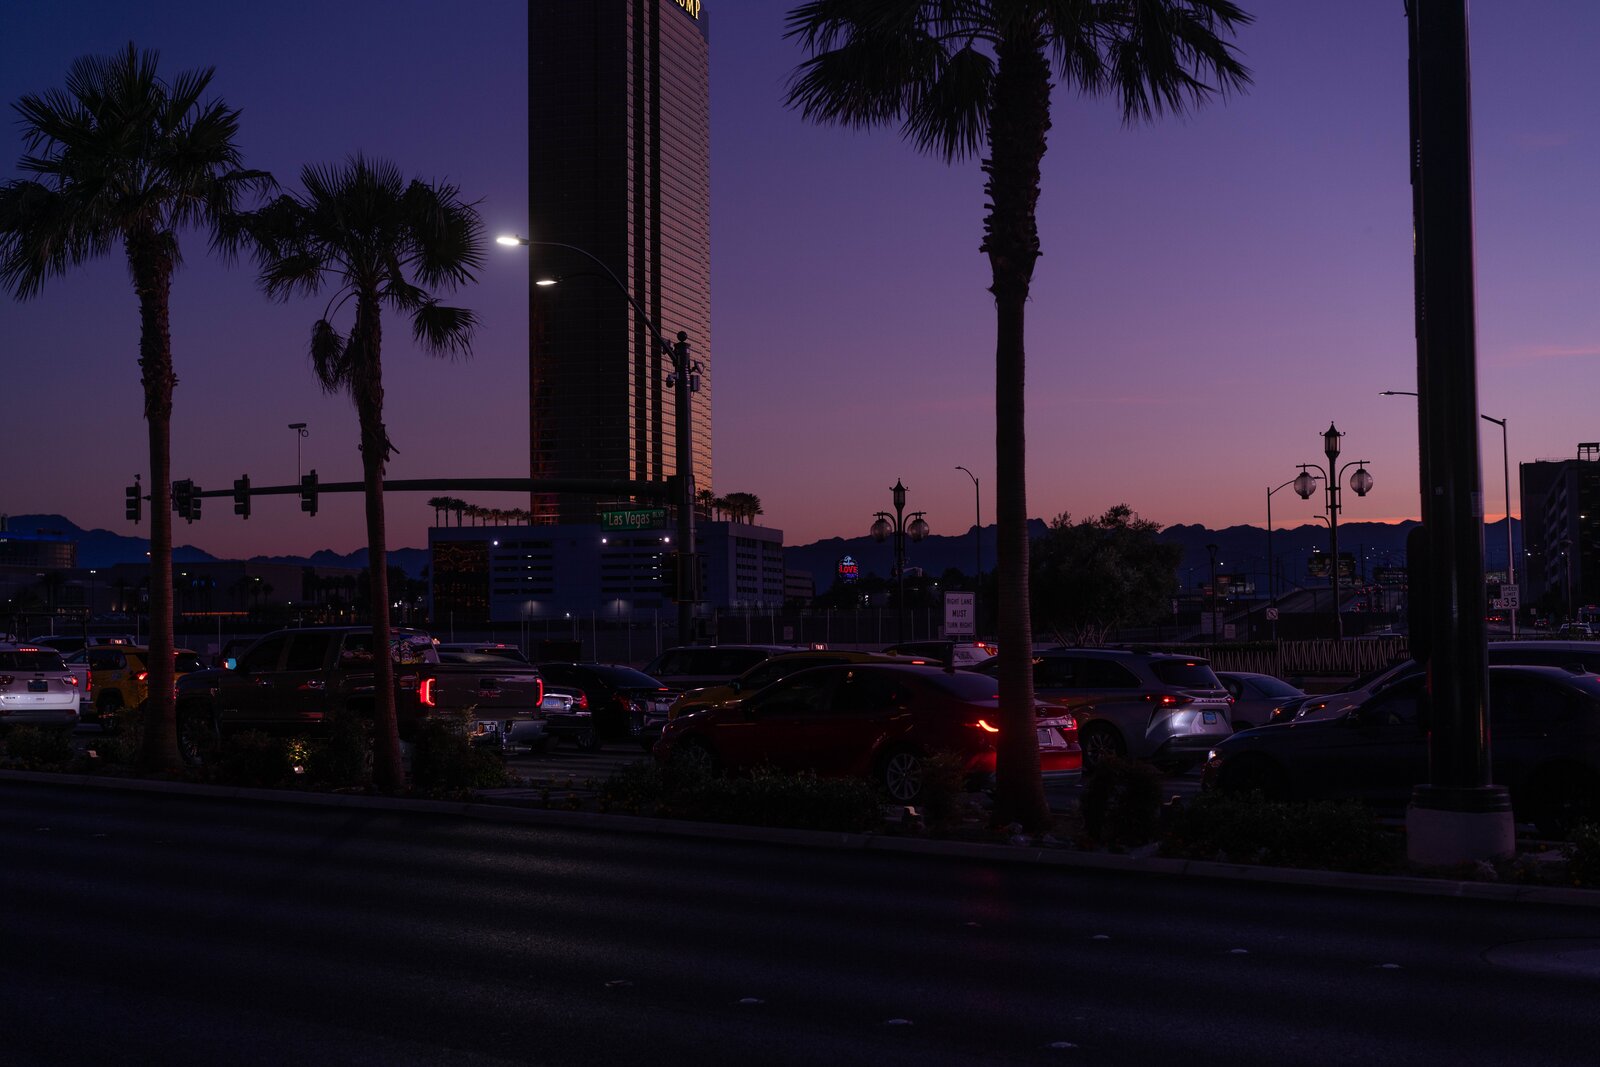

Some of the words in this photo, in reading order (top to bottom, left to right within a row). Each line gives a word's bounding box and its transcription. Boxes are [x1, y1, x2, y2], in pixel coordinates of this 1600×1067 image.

[608, 512, 623, 526] Las
[624, 511, 650, 529] Vegas
[652, 510, 665, 518] BLVD
[1503, 597, 1518, 607] 35
[952, 609, 967, 618] MUST
